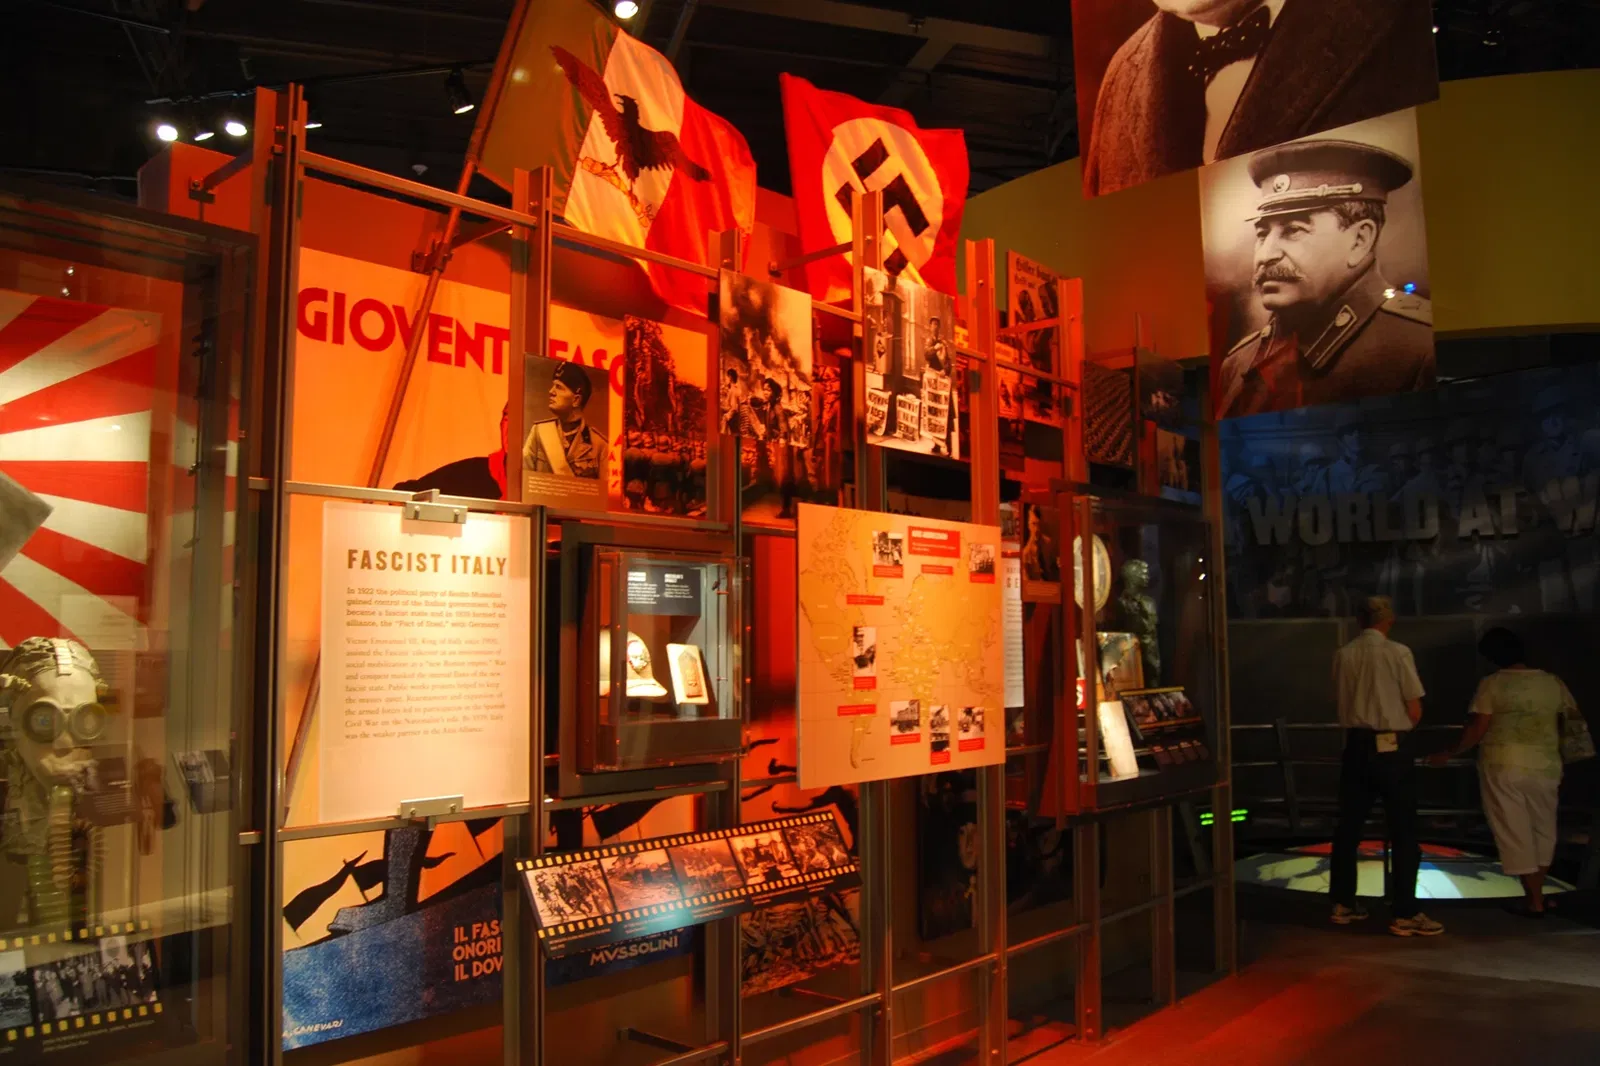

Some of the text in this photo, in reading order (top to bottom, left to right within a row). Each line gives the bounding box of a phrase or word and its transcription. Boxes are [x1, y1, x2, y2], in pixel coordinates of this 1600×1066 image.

[1249, 491, 1441, 546] WORLD
[1457, 484, 1523, 540] AT
[347, 549, 507, 576] FASCIST ITALY
[346, 587, 355, 595] In
[346, 598, 372, 606] gained
[346, 608, 376, 616] became
[380, 619, 393, 628] the
[454, 920, 500, 944] IL FAS
[588, 935, 679, 966] MVSSOLINI
[454, 956, 503, 982] IL DOV
